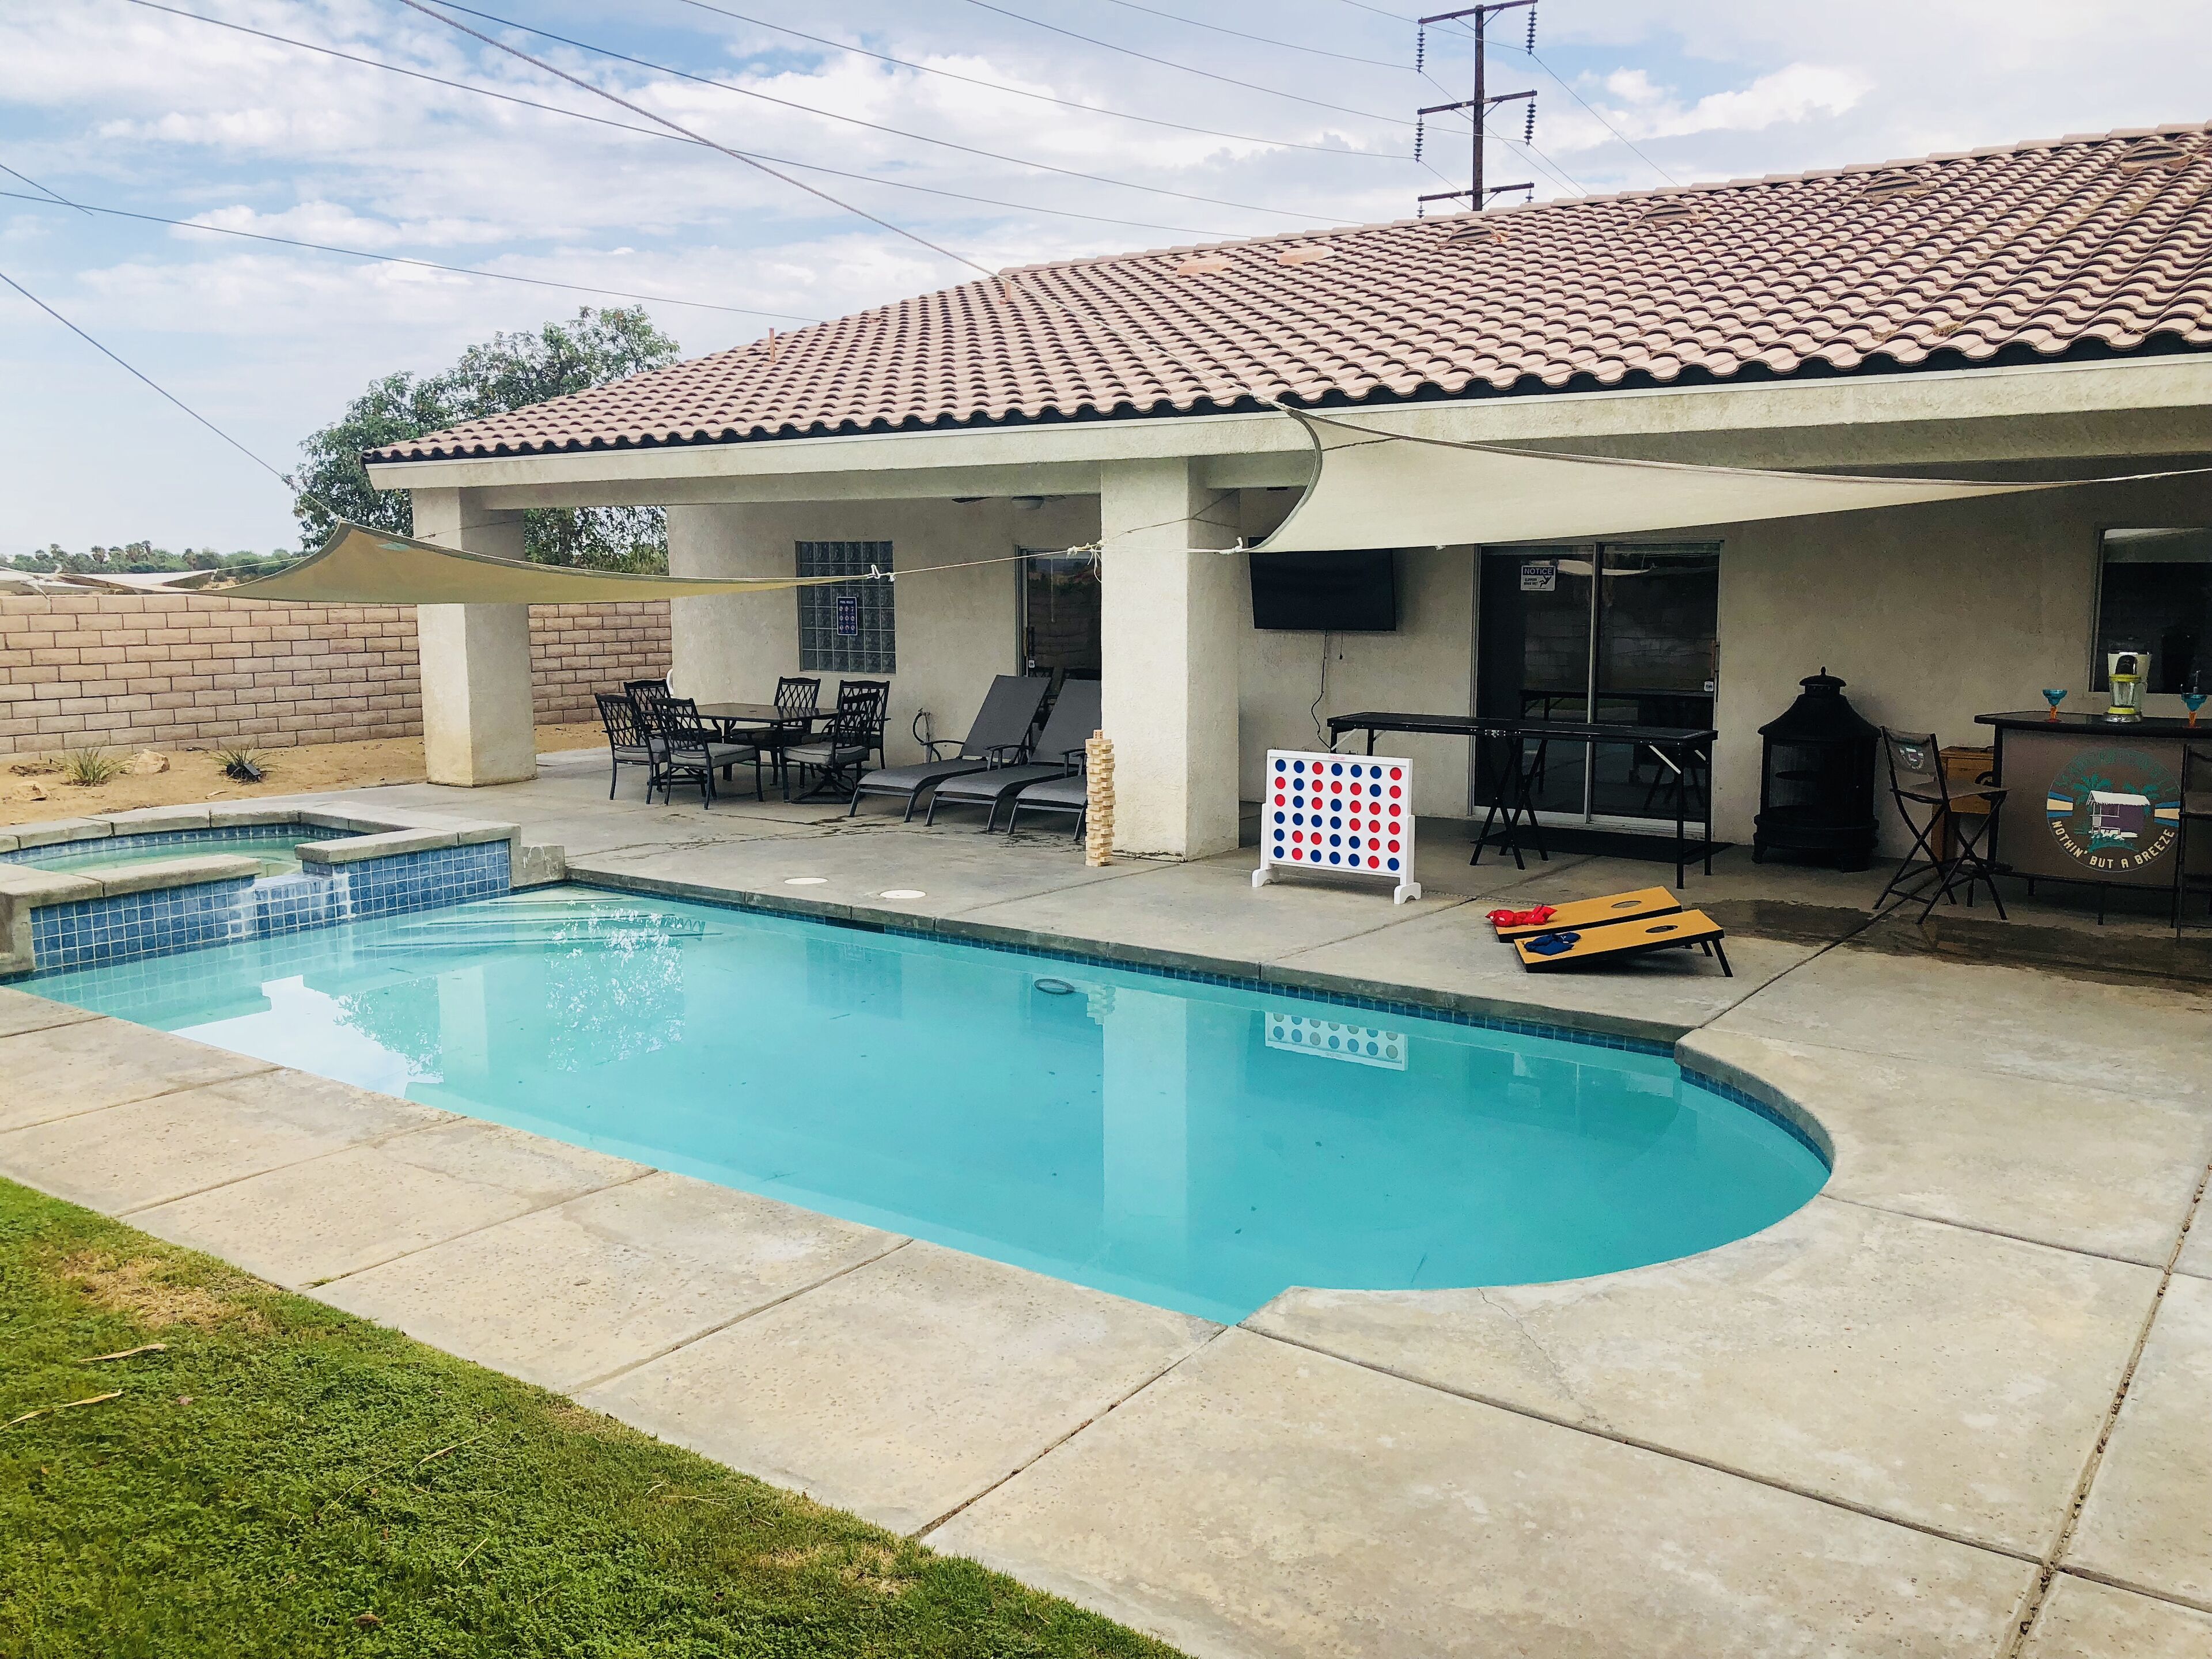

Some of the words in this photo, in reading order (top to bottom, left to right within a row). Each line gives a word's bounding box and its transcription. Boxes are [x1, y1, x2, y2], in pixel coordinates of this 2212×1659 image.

[2052, 820, 2088, 858] NOTHIN'
[2089, 855, 2114, 869] BUT
[2121, 858, 2129, 869] A
[2134, 829, 2175, 865] BREEZE
